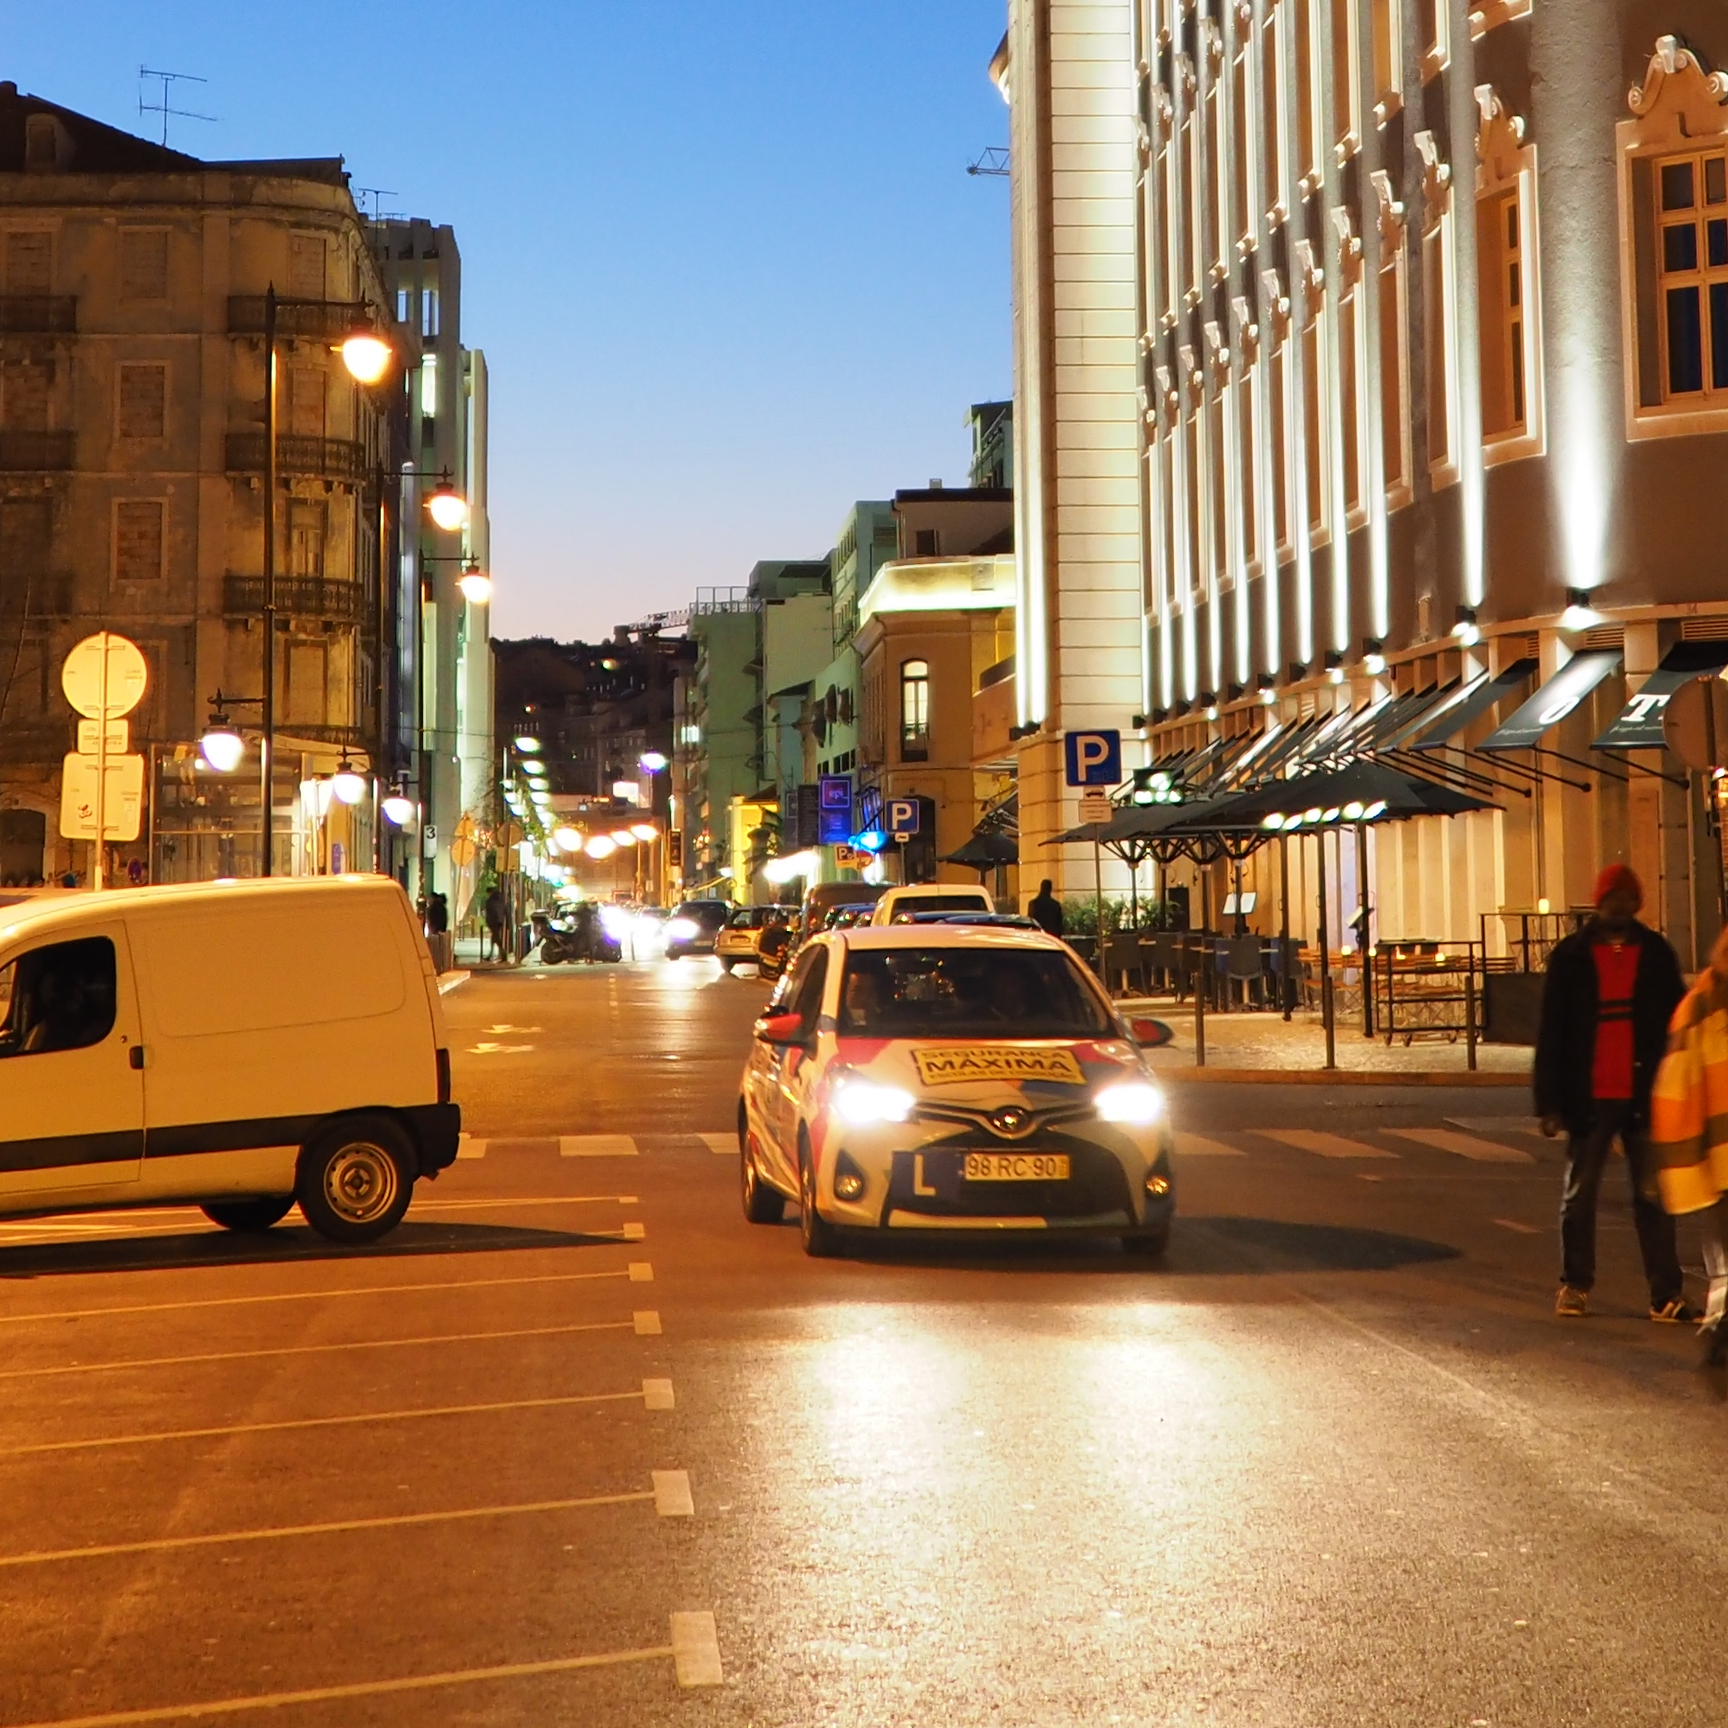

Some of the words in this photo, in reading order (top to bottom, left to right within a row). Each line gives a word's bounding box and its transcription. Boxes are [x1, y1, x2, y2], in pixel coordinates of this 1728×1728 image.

[1076, 735, 1109, 782] P
[426, 827, 436, 839] 3
[891, 802, 912, 830] P
[914, 1154, 936, 1195] L
